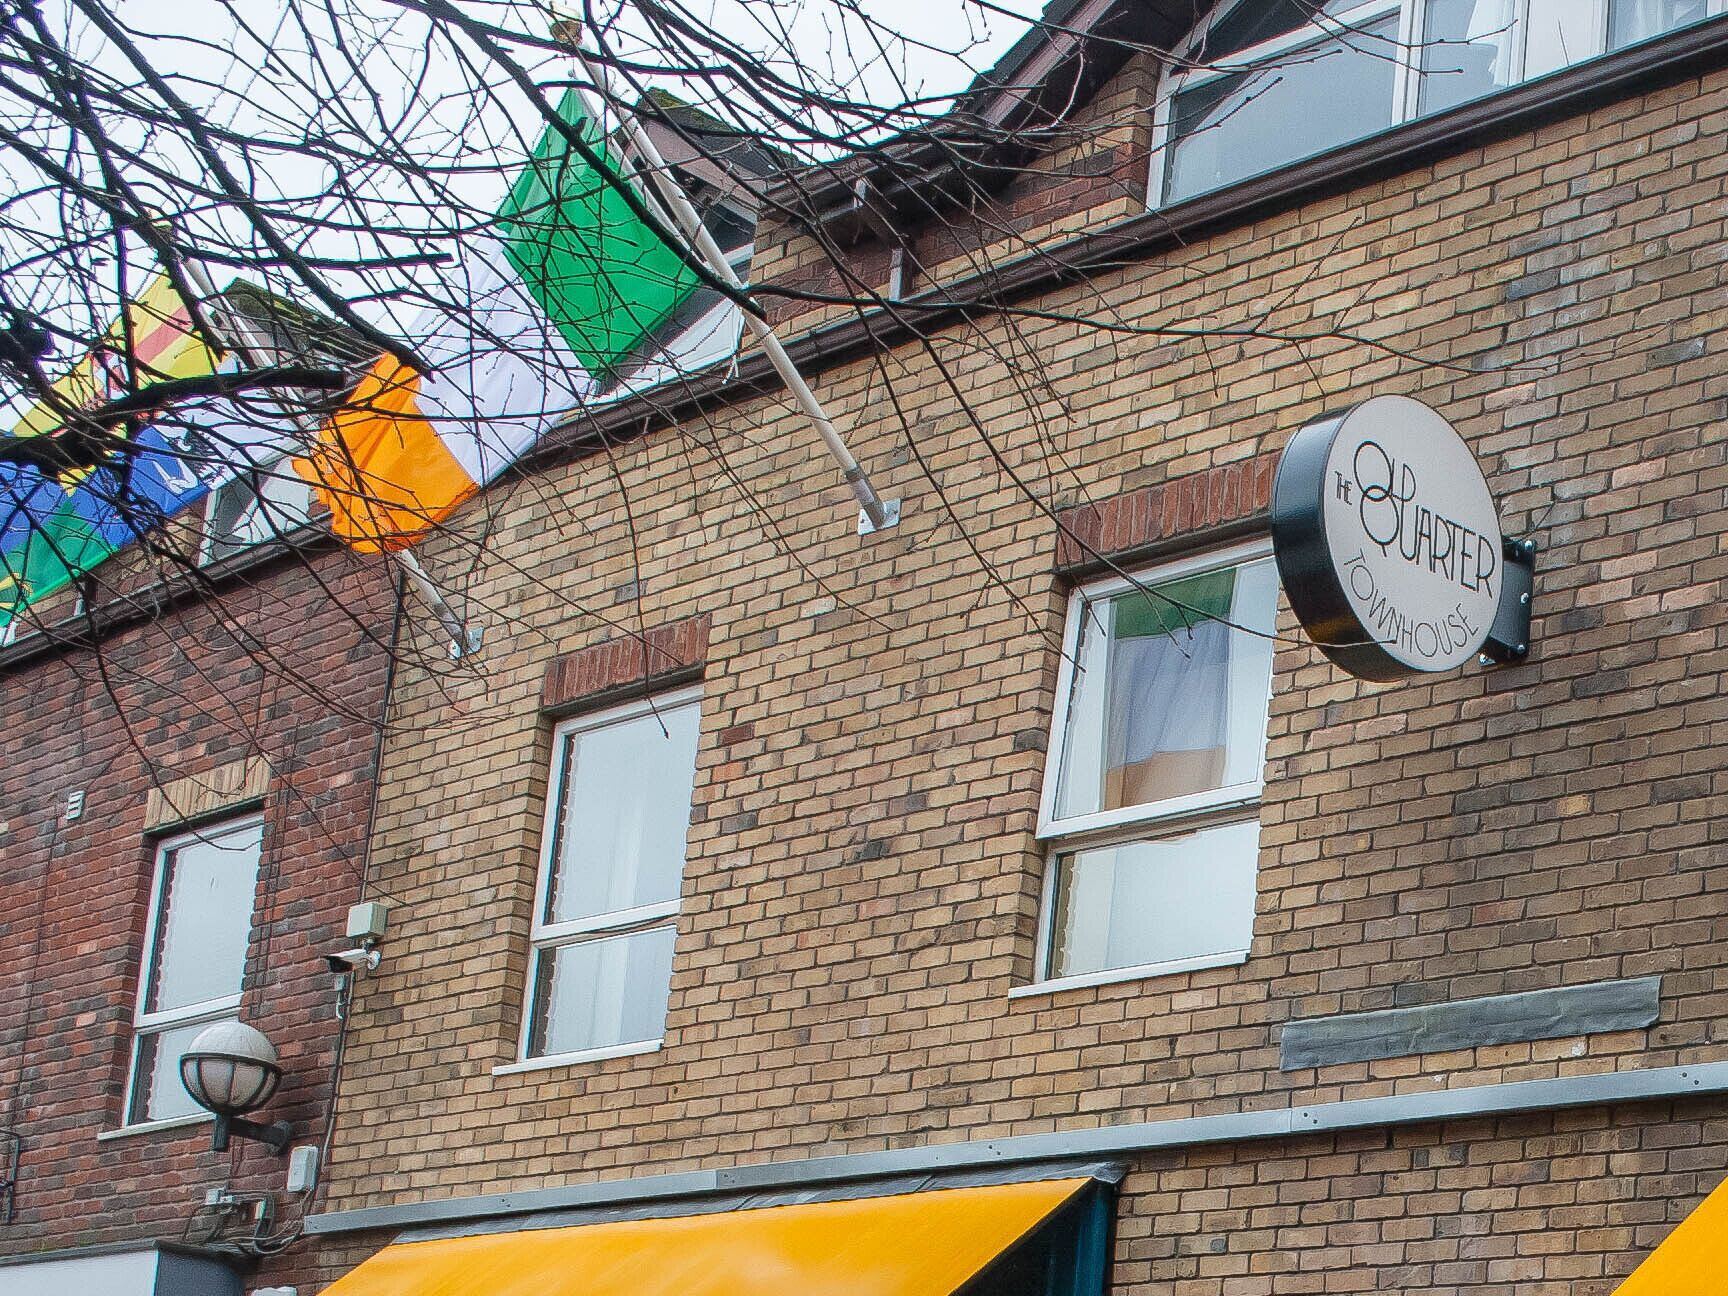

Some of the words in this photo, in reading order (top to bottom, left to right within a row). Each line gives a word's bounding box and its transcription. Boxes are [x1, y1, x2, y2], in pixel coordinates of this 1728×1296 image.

[1335, 470, 1353, 506] THE
[1354, 441, 1416, 503] OLD
[1360, 484, 1496, 600] QUARTER
[1344, 547, 1480, 659] TOWNHOUSE
